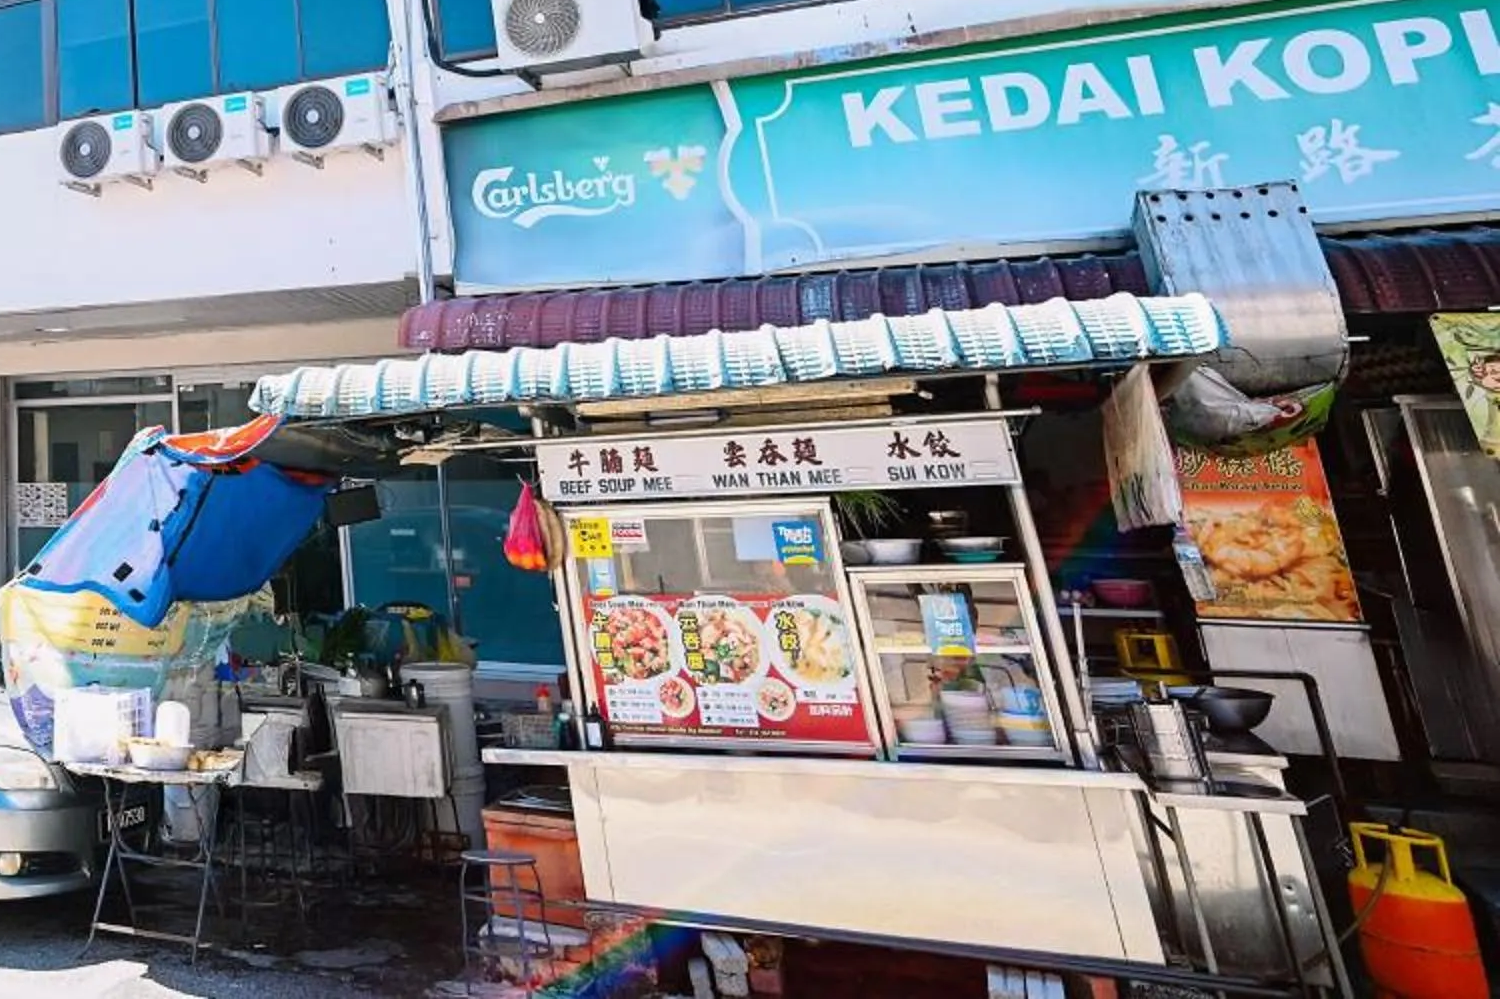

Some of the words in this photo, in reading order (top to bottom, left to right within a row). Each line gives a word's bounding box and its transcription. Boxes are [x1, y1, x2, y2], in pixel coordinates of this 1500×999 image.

[841, 54, 1166, 147] KEDAI
[1193, 8, 1500, 107] KOPI
[471, 159, 636, 223] Carlsberg
[559, 479, 593, 496] BEEF
[599, 478, 636, 494] SOUP
[643, 476, 674, 492] MEE
[712, 473, 749, 489] WAN
[756, 470, 801, 487] THAN
[808, 468, 843, 485] MEE
[887, 465, 917, 483] SUI
[925, 463, 966, 480] KOW
